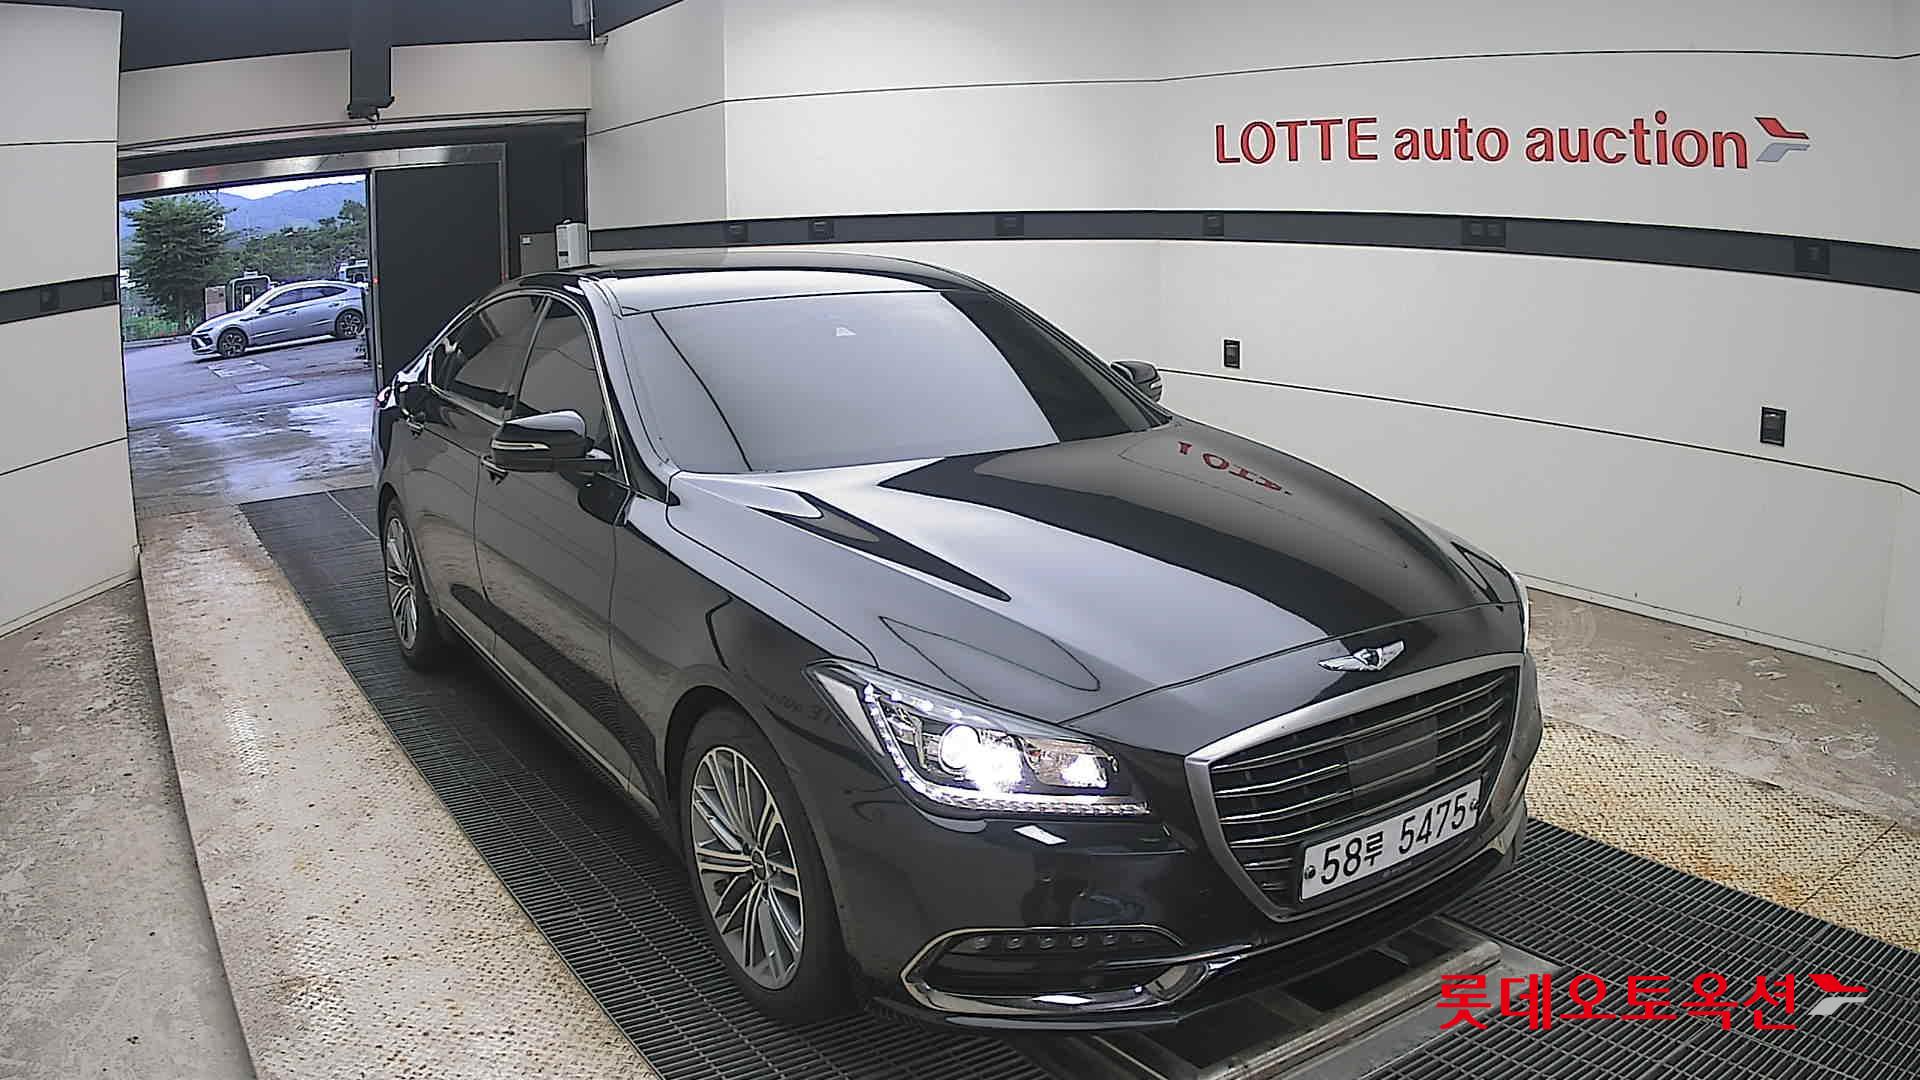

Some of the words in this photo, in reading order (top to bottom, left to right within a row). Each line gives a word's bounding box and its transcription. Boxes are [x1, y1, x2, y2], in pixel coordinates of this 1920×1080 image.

[1215, 117, 1378, 164] LOTTE
[1393, 117, 1509, 162] auto
[1525, 110, 1749, 169] auction
[1398, 792, 1468, 854] 5475
